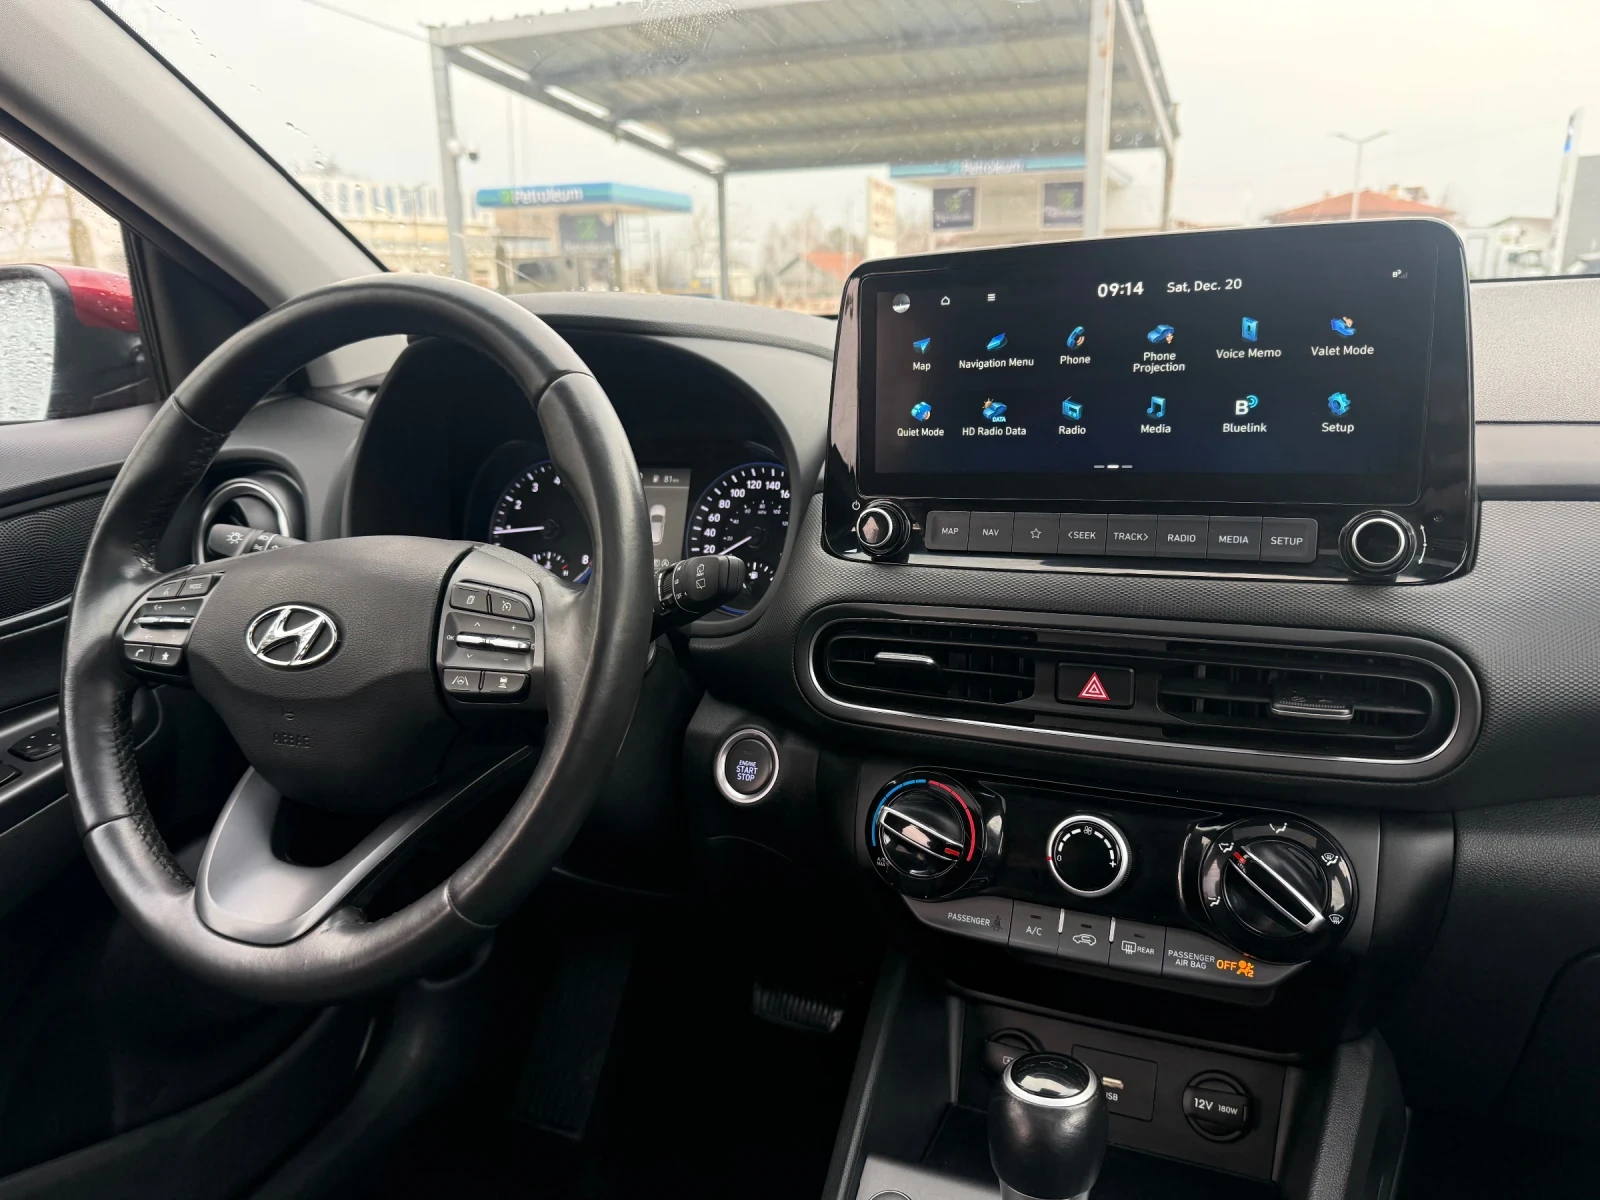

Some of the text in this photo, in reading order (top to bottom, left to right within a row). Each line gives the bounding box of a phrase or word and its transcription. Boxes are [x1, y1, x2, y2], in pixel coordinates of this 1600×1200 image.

[1097, 281, 1145, 298] 09:14
[1167, 278, 1242, 293] Sat, Dec. 20
[1143, 351, 1177, 361] Phone
[1216, 348, 1282, 359] Voice Memo
[1311, 345, 1375, 356] Valet Mode
[959, 357, 1034, 370] Navigation Menu
[1059, 354, 1091, 365] Phone
[912, 361, 931, 372] Map
[1132, 361, 1186, 374] Projection
[897, 427, 945, 438] Quiet Mode
[962, 426, 1027, 436] HD Radio Data
[1058, 424, 1087, 435] Radio
[1140, 423, 1172, 434] Media
[1222, 422, 1267, 433] Bluelink
[1321, 422, 1355, 434] Setup
[531, 482, 539, 492] 3
[746, 480, 762, 489] 120
[765, 481, 781, 490] 140
[730, 489, 746, 498] 100
[780, 489, 790, 499] 16
[514, 500, 522, 510] 2
[718, 499, 731, 509] 80
[708, 513, 721, 522] 60
[704, 528, 716, 537] 40
[941, 527, 959, 536] MAP
[982, 528, 1000, 536] NAV
[1167, 533, 1197, 543] RADIO
[1218, 534, 1249, 545] MEDIA
[1270, 536, 1304, 546] SETUP
[703, 544, 716, 554] 20
[582, 554, 590, 565] 8
[739, 759, 757, 767] ENGINE
[736, 765, 758, 774] START
[737, 773, 755, 781] STOP
[948, 911, 990, 927] PASSENGER
[1026, 925, 1043, 936] A/C
[1137, 945, 1155, 955] REAR
[1168, 949, 1216, 963] PASSENGER
[1175, 958, 1207, 970] AIR BAG
[1216, 959, 1238, 971] OFF
[1194, 1097, 1238, 1115] 12V 180W
